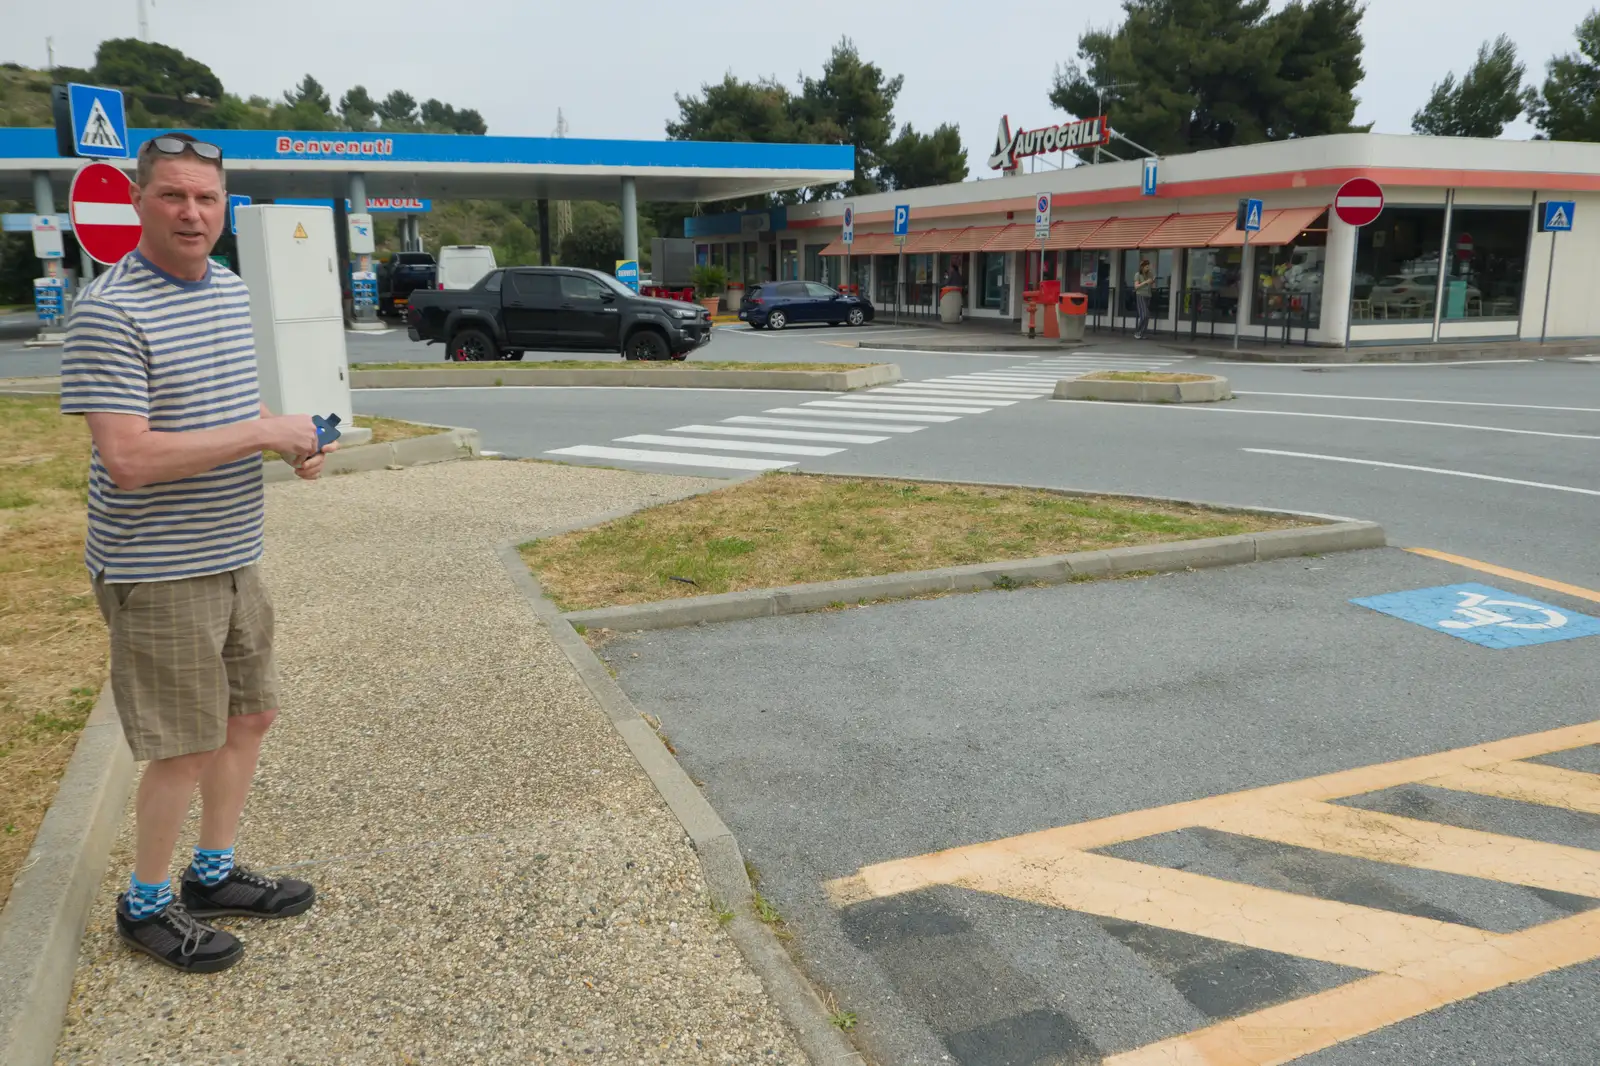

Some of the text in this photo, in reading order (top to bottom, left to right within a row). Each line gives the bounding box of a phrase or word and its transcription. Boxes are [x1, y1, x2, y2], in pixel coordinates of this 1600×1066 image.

[277, 137, 393, 156] Benvenuti
[1015, 119, 1101, 154] AUTOGRILL
[345, 198, 423, 209] MOIL
[896, 207, 906, 233] P
